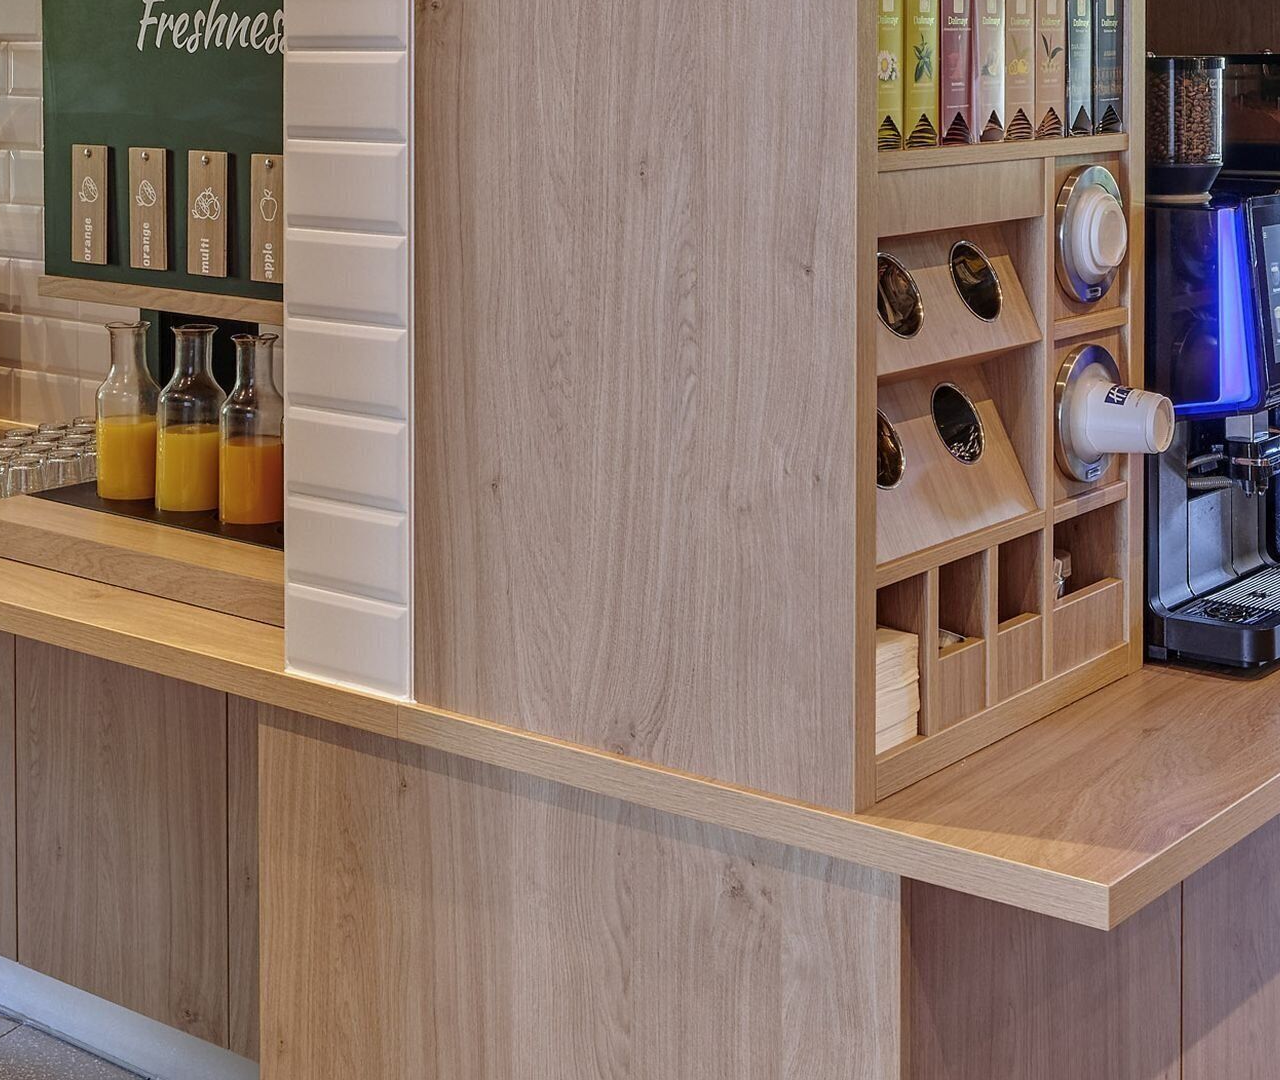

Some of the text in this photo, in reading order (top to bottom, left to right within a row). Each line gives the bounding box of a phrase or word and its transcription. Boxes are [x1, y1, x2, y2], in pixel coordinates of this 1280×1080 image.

[84, 217, 93, 261] orange
[143, 222, 152, 267] orange
[200, 238, 210, 274] multi
[262, 242, 275, 280] apple
